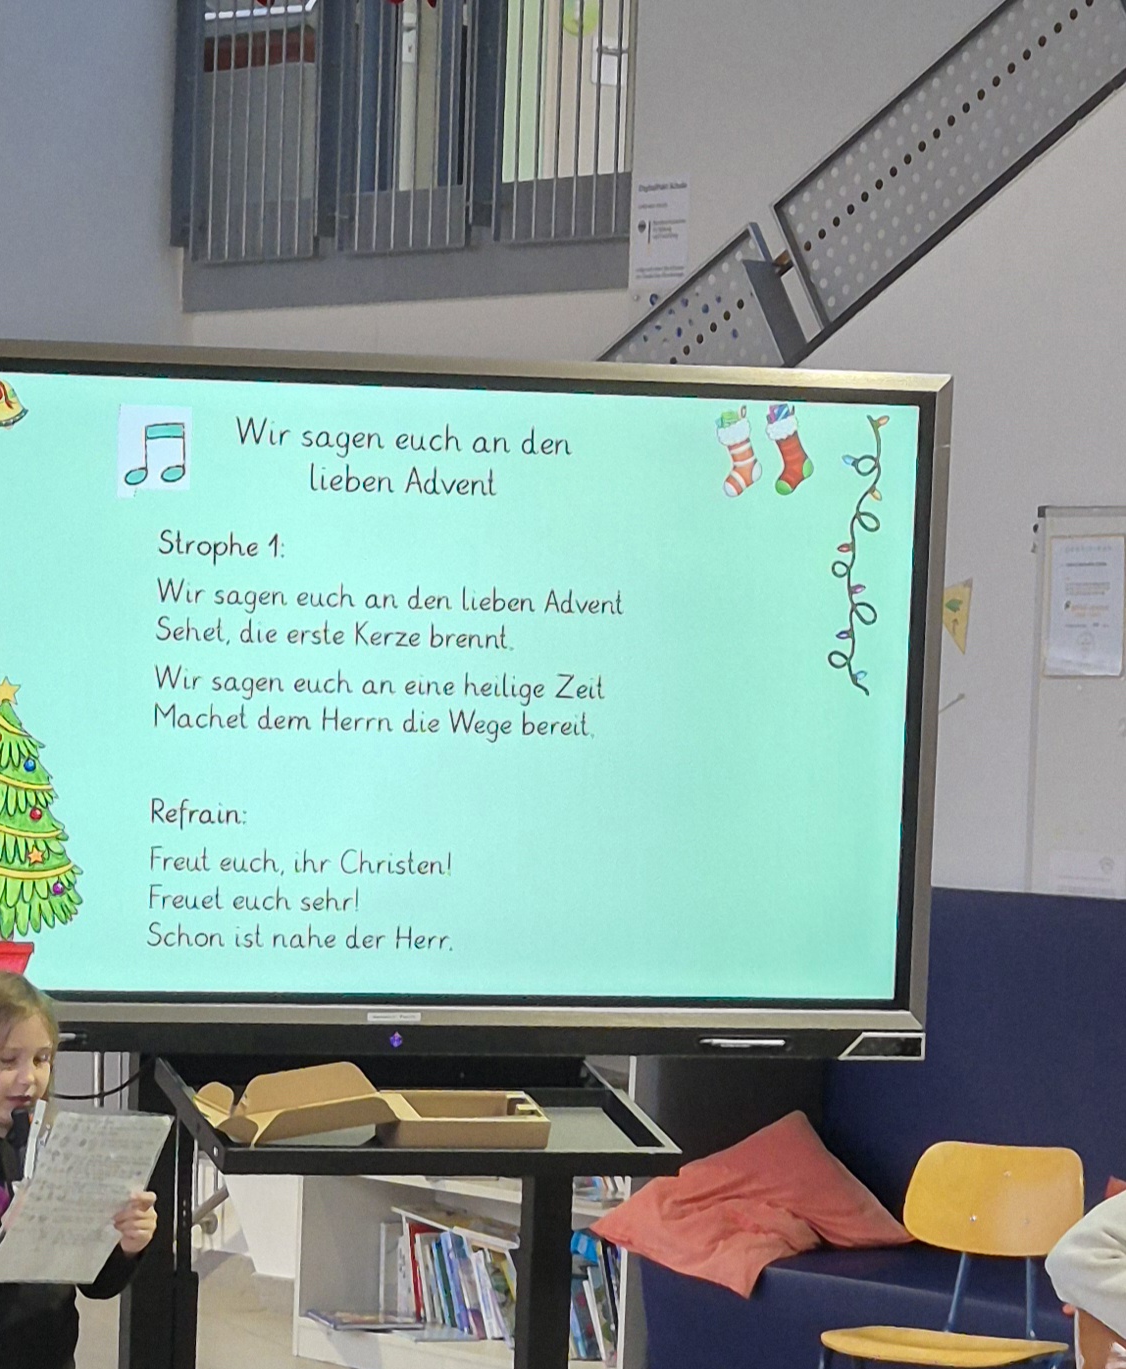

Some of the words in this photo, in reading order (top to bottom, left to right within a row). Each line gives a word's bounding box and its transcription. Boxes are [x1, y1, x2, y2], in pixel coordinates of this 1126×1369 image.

[235, 415, 292, 447] Wir
[300, 429, 385, 459] sagen
[395, 422, 463, 453] euch
[471, 435, 511, 454] an
[520, 425, 573, 456] den
[310, 461, 395, 494] lieben
[404, 465, 497, 497] Advent
[158, 528, 259, 567] Strophe
[267, 532, 285, 559] 1:
[156, 576, 205, 605] Wir
[213, 589, 288, 614] sagen
[296, 582, 356, 609] euch
[364, 593, 399, 610] an
[407, 584, 453, 611] den
[462, 585, 536, 613] lieben
[543, 588, 624, 616] Advent
[155, 616, 231, 646] Sehet,
[239, 617, 278, 644] die
[286, 619, 345, 646] erste
[355, 620, 421, 648] Kerze
[154, 664, 203, 691] Wir
[210, 675, 285, 701] sagen
[293, 669, 354, 695] euch
[361, 679, 397, 695] an
[404, 679, 455, 697] eine
[464, 671, 545, 707] heilige
[554, 673, 606, 700] Zeit
[153, 698, 251, 730] Machet
[257, 704, 312, 732] dem
[321, 705, 394, 733] Herrn
[402, 708, 440, 734] die
[448, 707, 513, 744] Wege
[151, 797, 248, 831] Refrain:
[150, 845, 211, 873] Freut
[219, 847, 285, 877] euch,
[294, 848, 332, 874] ihr
[340, 848, 452, 876] Christen!
[148, 883, 224, 911] Freuet
[232, 885, 292, 912] euch
[299, 886, 359, 912] sehr!
[146, 921, 226, 948] Schon
[234, 923, 265, 949] ist
[272, 923, 337, 950] nahe
[345, 923, 386, 950] der
[395, 925, 453, 952] Herr.
